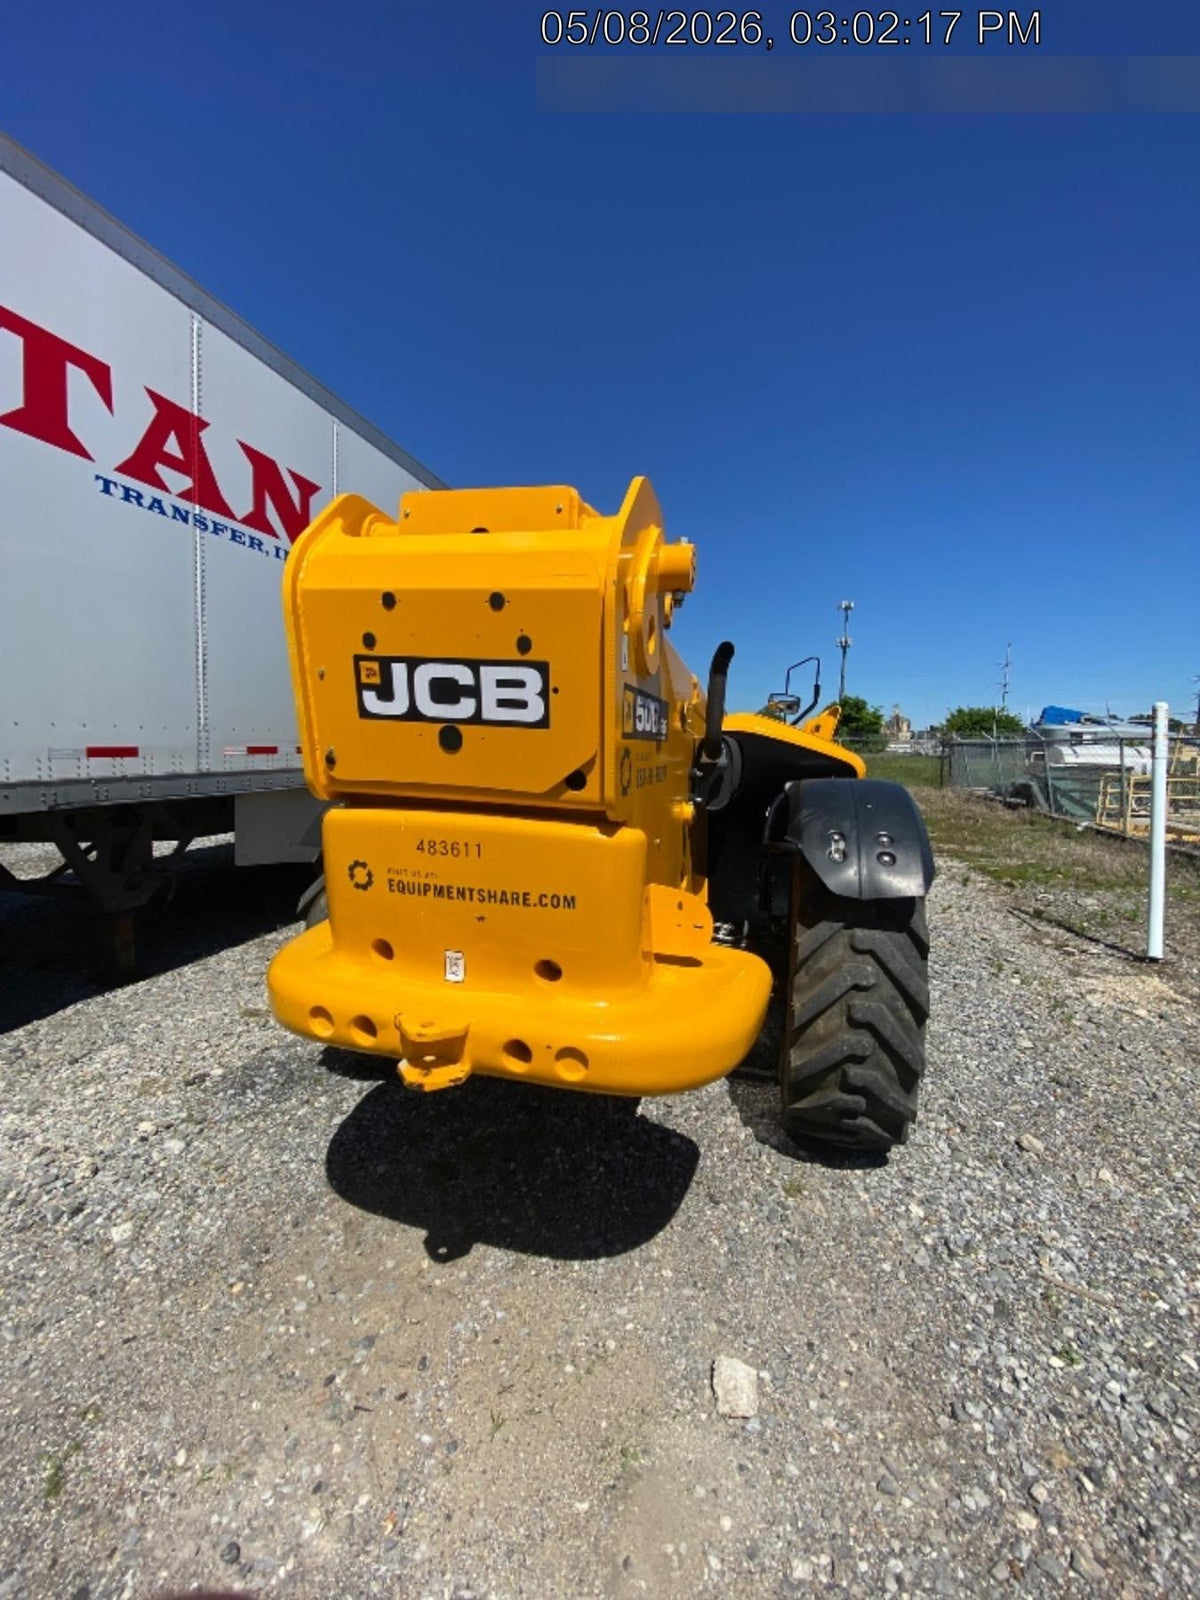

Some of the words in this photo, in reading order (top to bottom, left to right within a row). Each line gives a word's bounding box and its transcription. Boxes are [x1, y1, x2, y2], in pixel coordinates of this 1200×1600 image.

[94, 474, 270, 557] TRANSFER,
[362, 662, 545, 723] JCB
[416, 839, 482, 858] 483611
[387, 878, 577, 910] EQUIPMENTSHARE.COM
